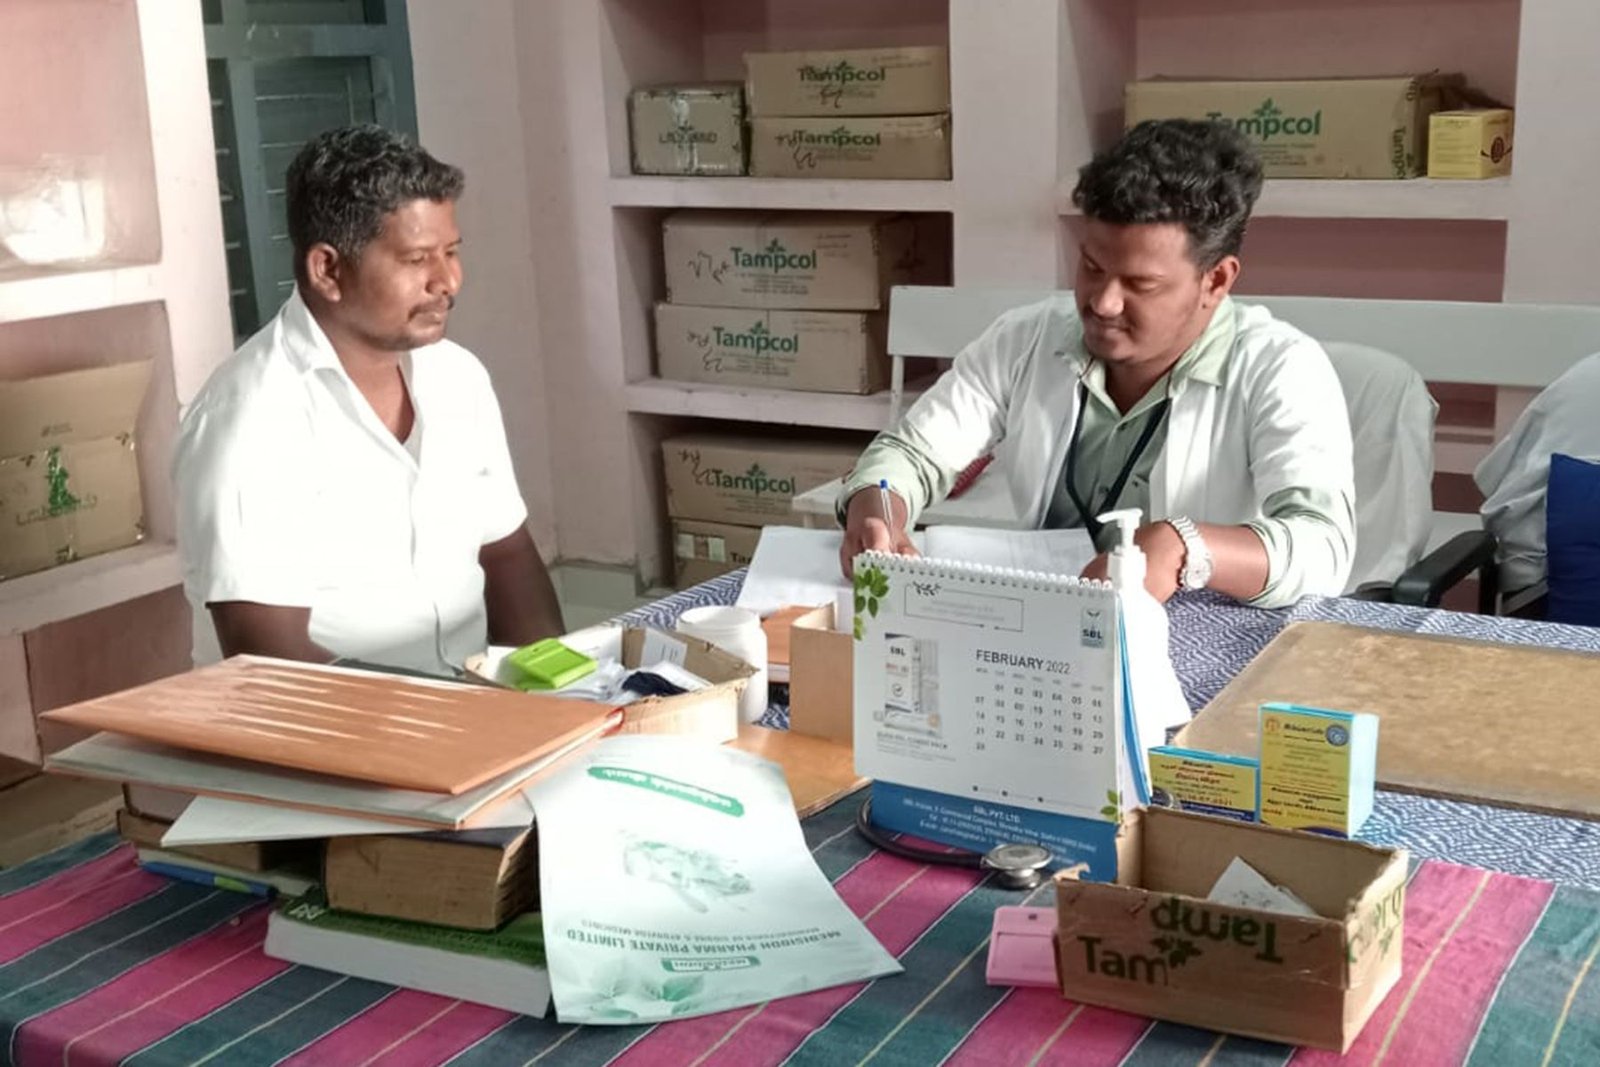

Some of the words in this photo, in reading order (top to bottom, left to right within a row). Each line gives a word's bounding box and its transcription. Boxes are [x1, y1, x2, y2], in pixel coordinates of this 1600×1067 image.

[798, 66, 885, 84] Tampcol
[797, 129, 881, 147] Tampcol
[730, 247, 817, 273] Tampcol
[713, 327, 799, 354] Tampcol
[711, 469, 796, 496] Tampcol
[1082, 628, 1102, 639] SBL
[976, 649, 1043, 670] FEBRUARY
[1046, 660, 1071, 675] 2022
[567, 928, 625, 949] LIMITED
[1151, 896, 1283, 963] Tamp
[629, 939, 689, 953] PRIVATE
[693, 943, 756, 955] PHARMA
